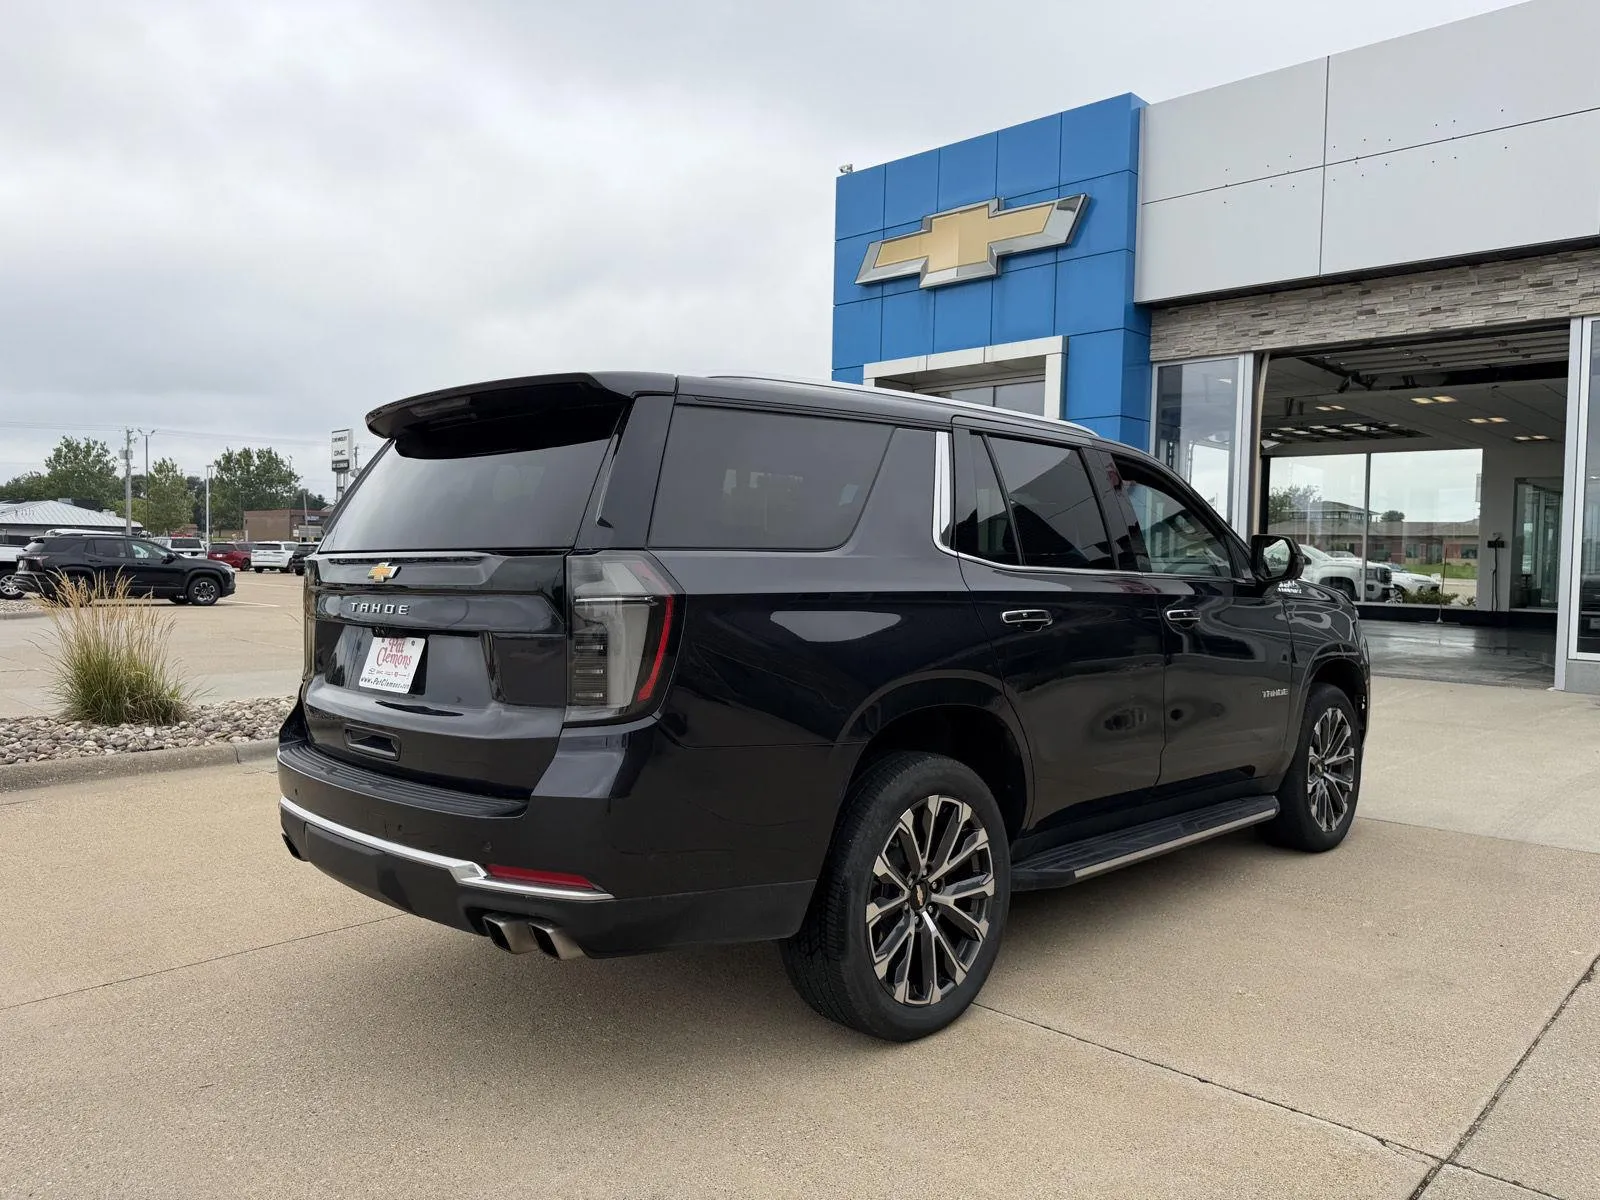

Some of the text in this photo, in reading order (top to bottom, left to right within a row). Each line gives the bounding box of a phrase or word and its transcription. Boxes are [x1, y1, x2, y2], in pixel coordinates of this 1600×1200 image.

[351, 602, 409, 615] TAHOE
[388, 637, 406, 653] Pat
[376, 647, 412, 669] Clemons
